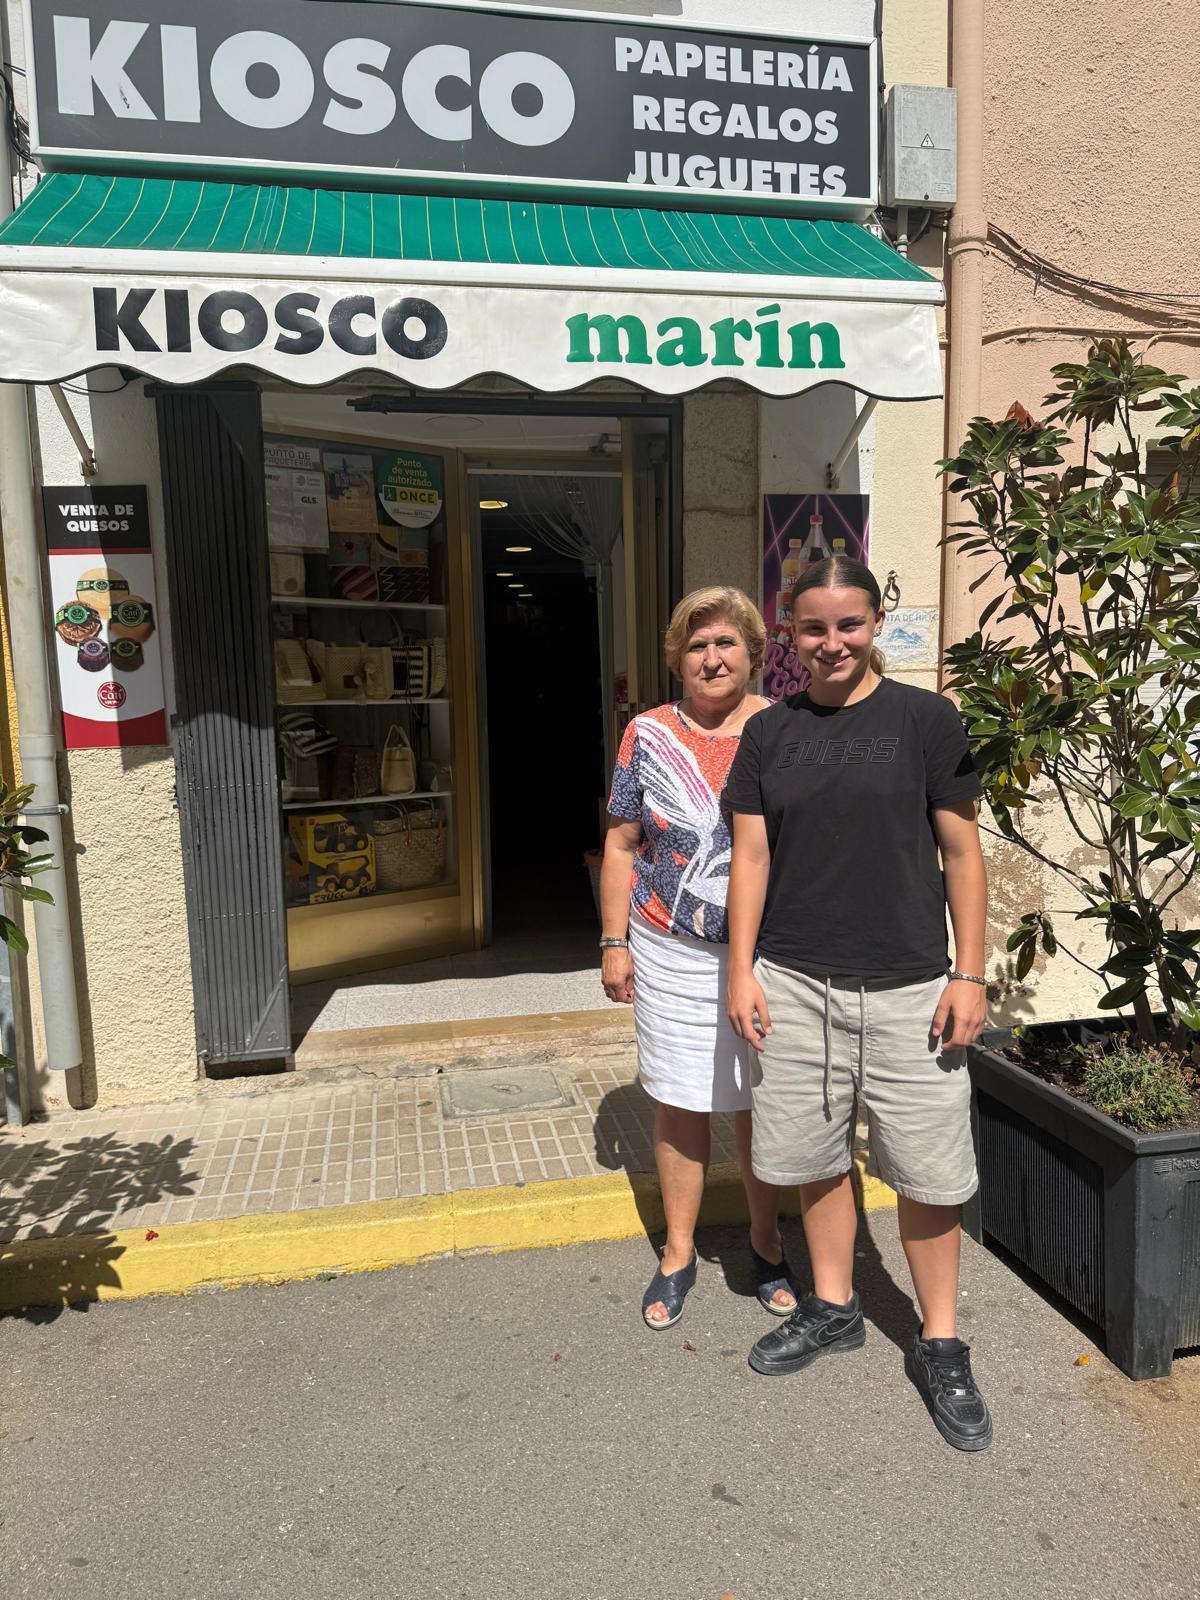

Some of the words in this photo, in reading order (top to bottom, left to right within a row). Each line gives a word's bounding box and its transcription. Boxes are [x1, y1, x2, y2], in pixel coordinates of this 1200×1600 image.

[614, 37, 854, 92] PAPELERÍA
[52, 15, 576, 147] KIOSCO
[632, 95, 839, 145] REGALOS
[626, 150, 848, 197] JUGUETES
[93, 287, 449, 361] KIOSCO
[564, 303, 847, 369] marín
[391, 466, 403, 475] de
[404, 469, 428, 477] venta
[396, 457, 422, 467] Punto
[387, 475, 433, 487] autorizado
[58, 504, 110, 516] VENTA
[114, 504, 135, 516] DE
[399, 490, 435, 504] ONCE
[66, 520, 130, 532] QUESOS
